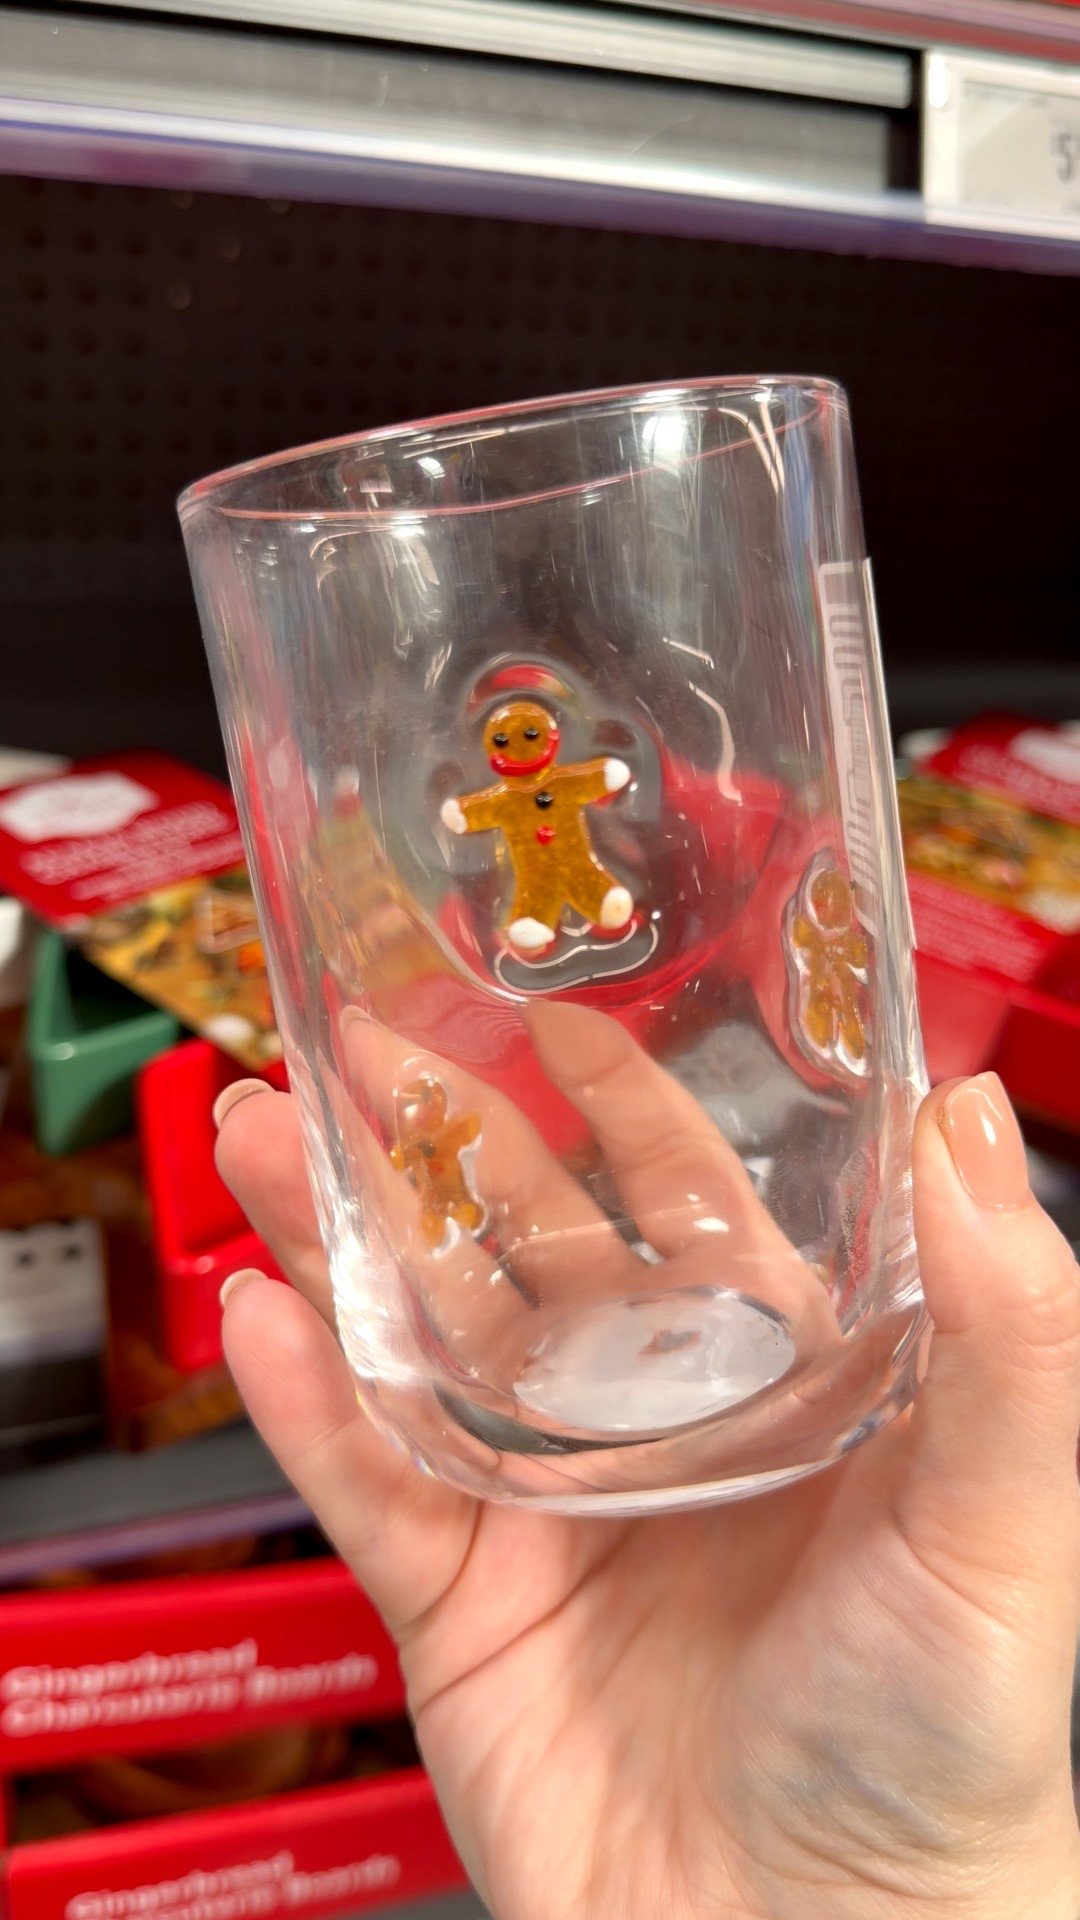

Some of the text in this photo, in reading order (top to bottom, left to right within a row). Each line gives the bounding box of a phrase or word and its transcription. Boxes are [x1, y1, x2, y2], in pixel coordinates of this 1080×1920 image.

[1, 1638, 257, 1702] Gingerbread
[1, 1652, 378, 1738] Charcuterie Boards
[281, 1854, 401, 1909] Boards
